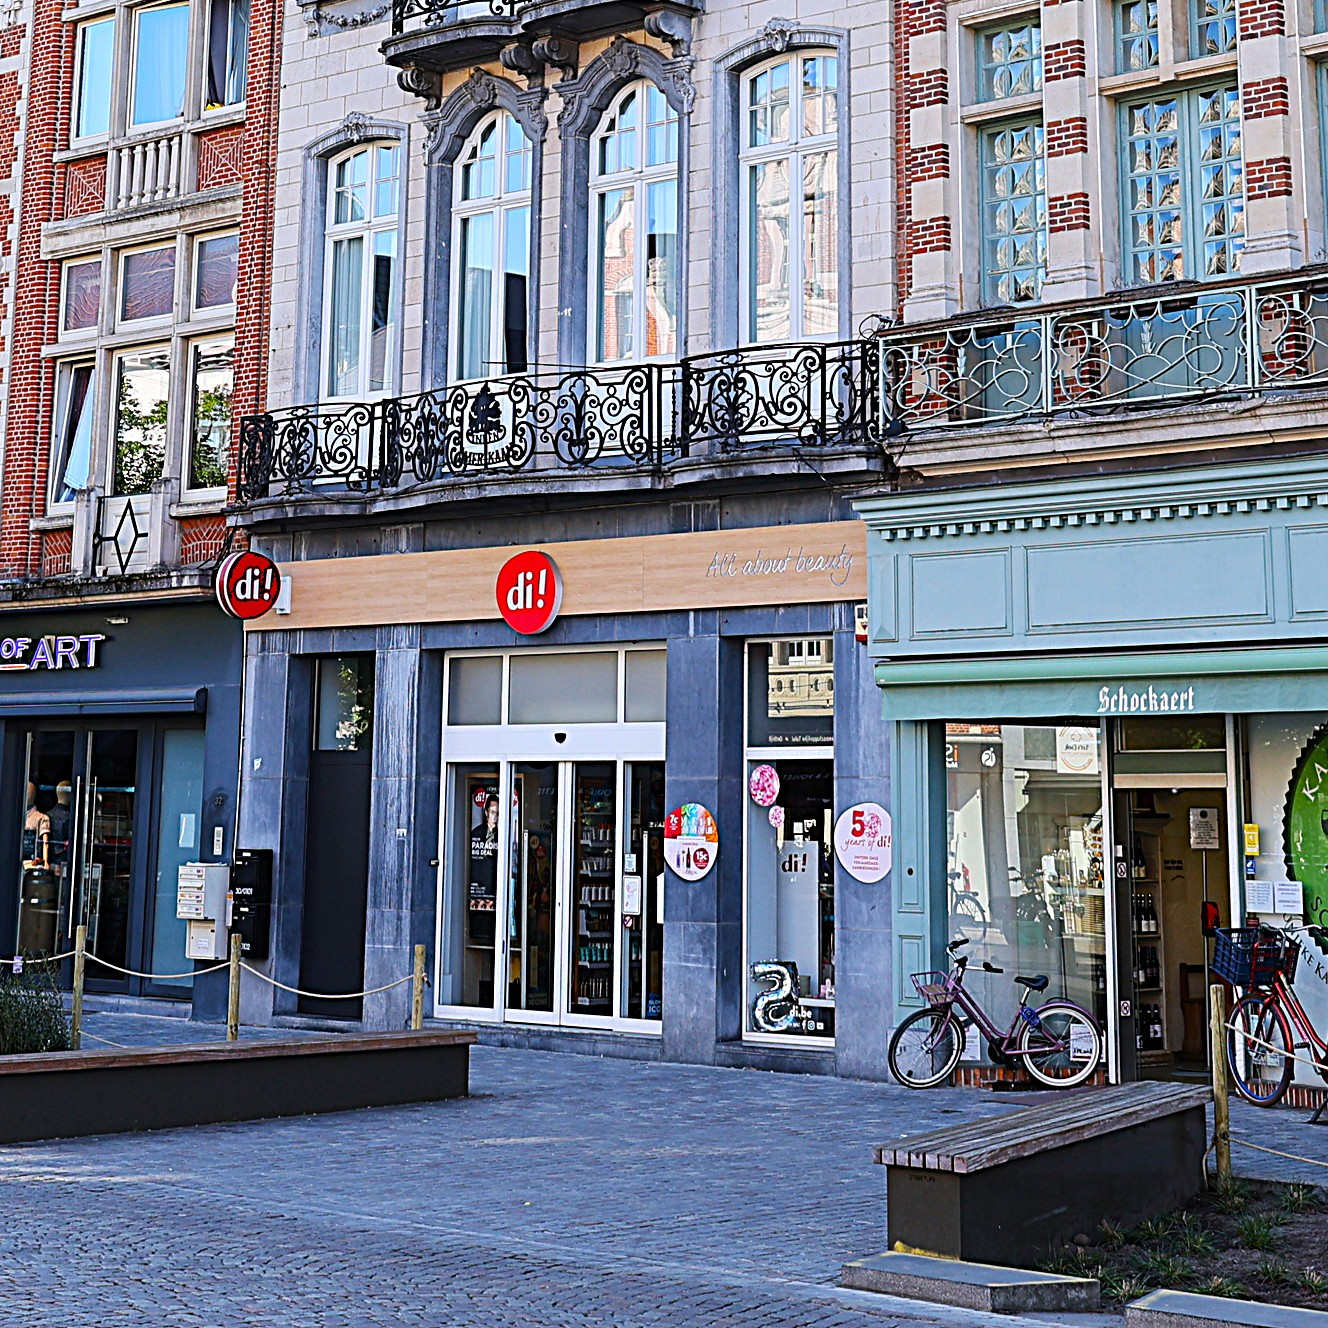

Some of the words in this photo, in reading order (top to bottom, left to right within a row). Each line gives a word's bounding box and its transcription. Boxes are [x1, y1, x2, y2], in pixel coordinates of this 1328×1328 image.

[706, 551, 738, 577] All
[742, 546, 793, 576] about
[795, 543, 853, 587] beauty
[235, 567, 273, 601] di!
[506, 568, 548, 611] di!
[0, 637, 32, 660] OF
[30, 634, 106, 670] ART
[1096, 684, 1195, 713] Schockaert
[877, 835, 892, 848] di!
[781, 852, 807, 873] di!
[789, 1004, 812, 1019] di.be
